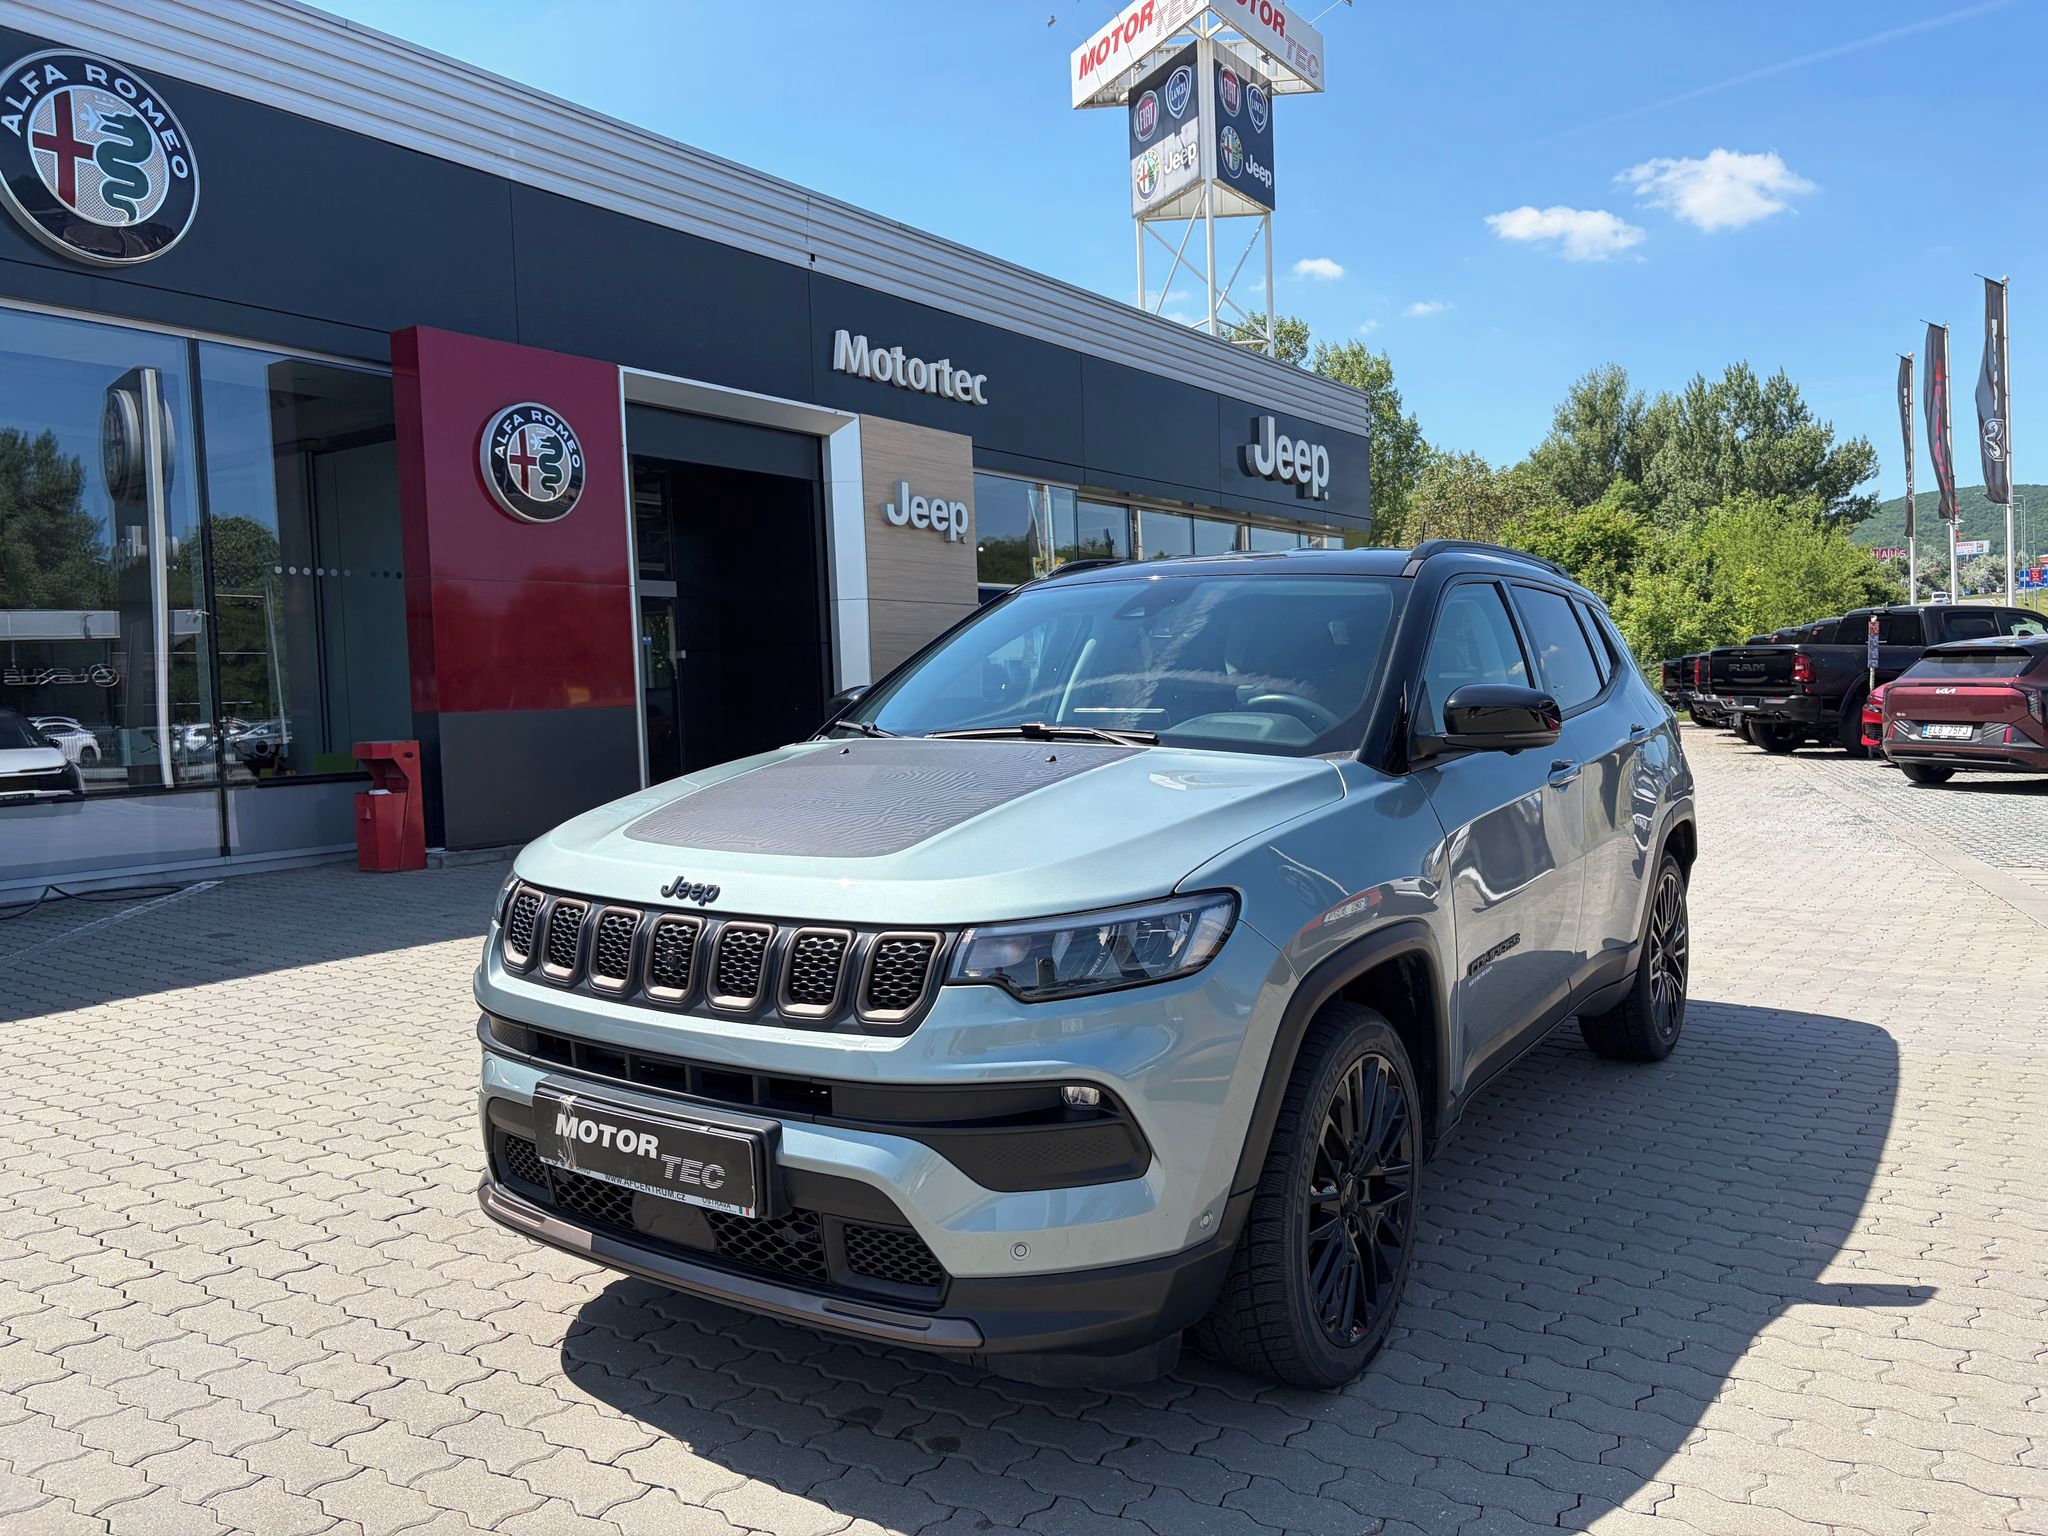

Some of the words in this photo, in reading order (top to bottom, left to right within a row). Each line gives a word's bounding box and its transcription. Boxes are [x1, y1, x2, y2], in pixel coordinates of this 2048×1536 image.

[1079, 0, 1154, 80] MOTOR
[1285, 34, 1319, 79] TEC
[1, 64, 68, 138] ALFA
[84, 63, 189, 179] ROMEO
[1139, 102, 1154, 132] FIAT
[1163, 142, 1198, 175] Jeep
[1245, 154, 1273, 188] Jeep
[833, 329, 988, 405] Motortec
[494, 413, 525, 459] ALFA
[530, 410, 581, 468] ROMEO
[1245, 415, 1330, 499] Jeep
[881, 480, 969, 543] Jeep
[1728, 663, 1766, 672] RAM
[660, 875, 721, 907] Jeep
[555, 1113, 659, 1159] MOTOR
[660, 1153, 726, 1189] TEC
